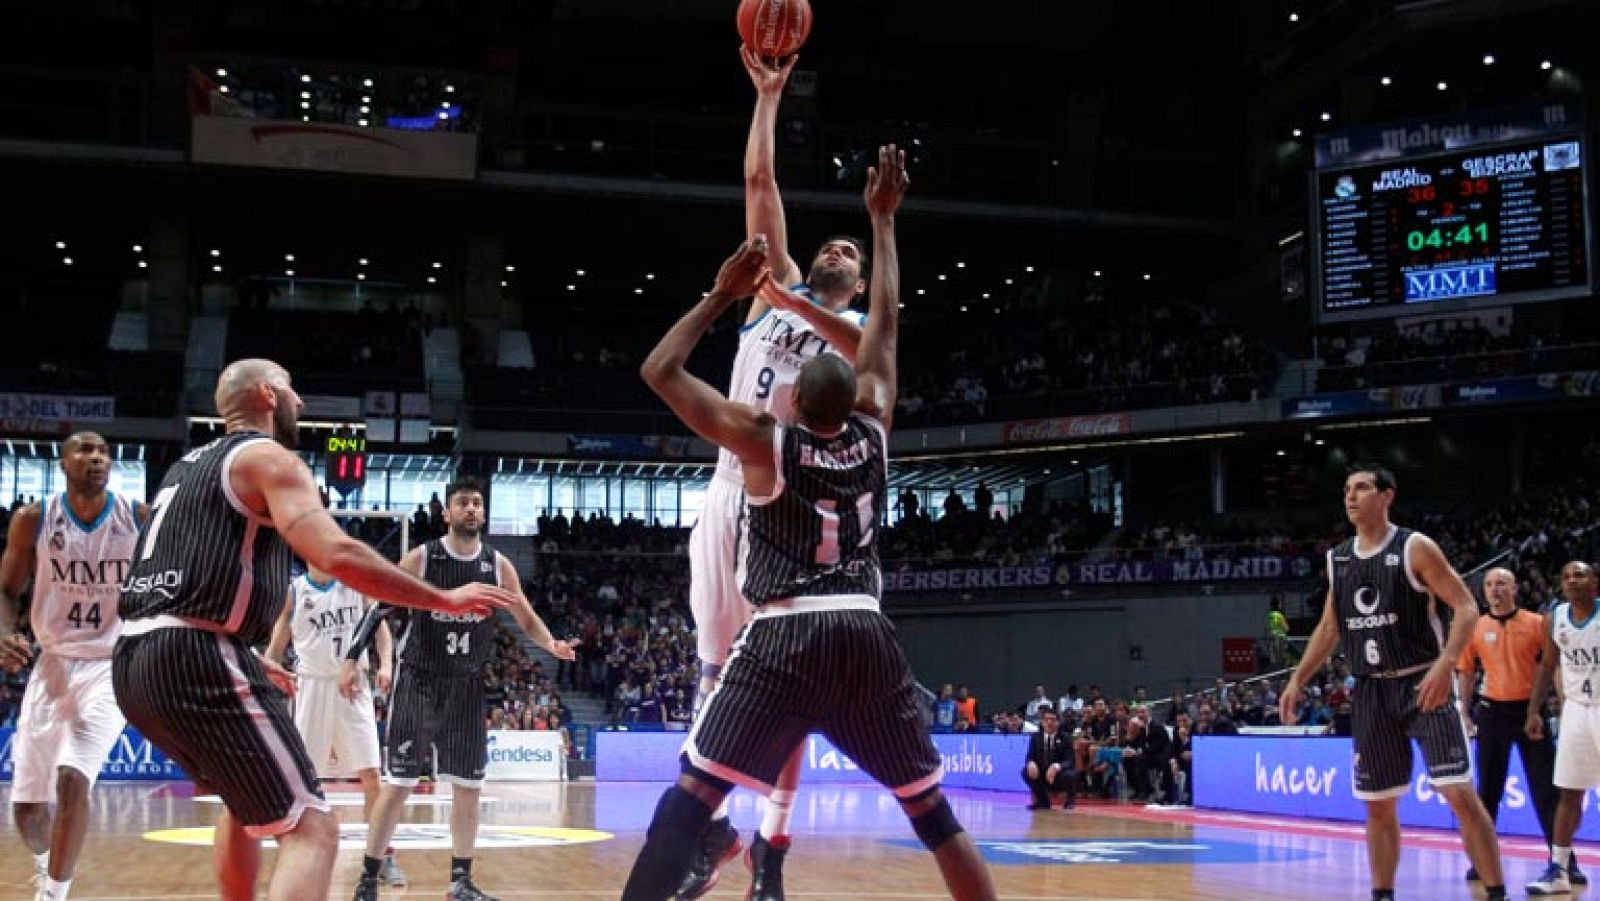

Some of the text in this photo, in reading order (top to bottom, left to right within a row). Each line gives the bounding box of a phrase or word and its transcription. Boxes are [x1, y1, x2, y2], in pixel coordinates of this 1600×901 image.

[1372, 173, 1432, 192] MADRID
[1407, 222, 1489, 251] 04:41
[1408, 267, 1490, 295] MMT
[756, 366, 775, 399] 9
[339, 454, 363, 479] 11
[50, 558, 131, 585] MMT
[1080, 562, 1153, 583] REAL
[1170, 557, 1282, 581] MADRID
[68, 601, 102, 629] 44
[333, 637, 342, 656] 7
[446, 632, 470, 655] 34
[1365, 639, 1380, 664] 6
[1582, 678, 1593, 699] 4
[490, 744, 553, 763] endesa
[1254, 750, 1339, 795] hacer
